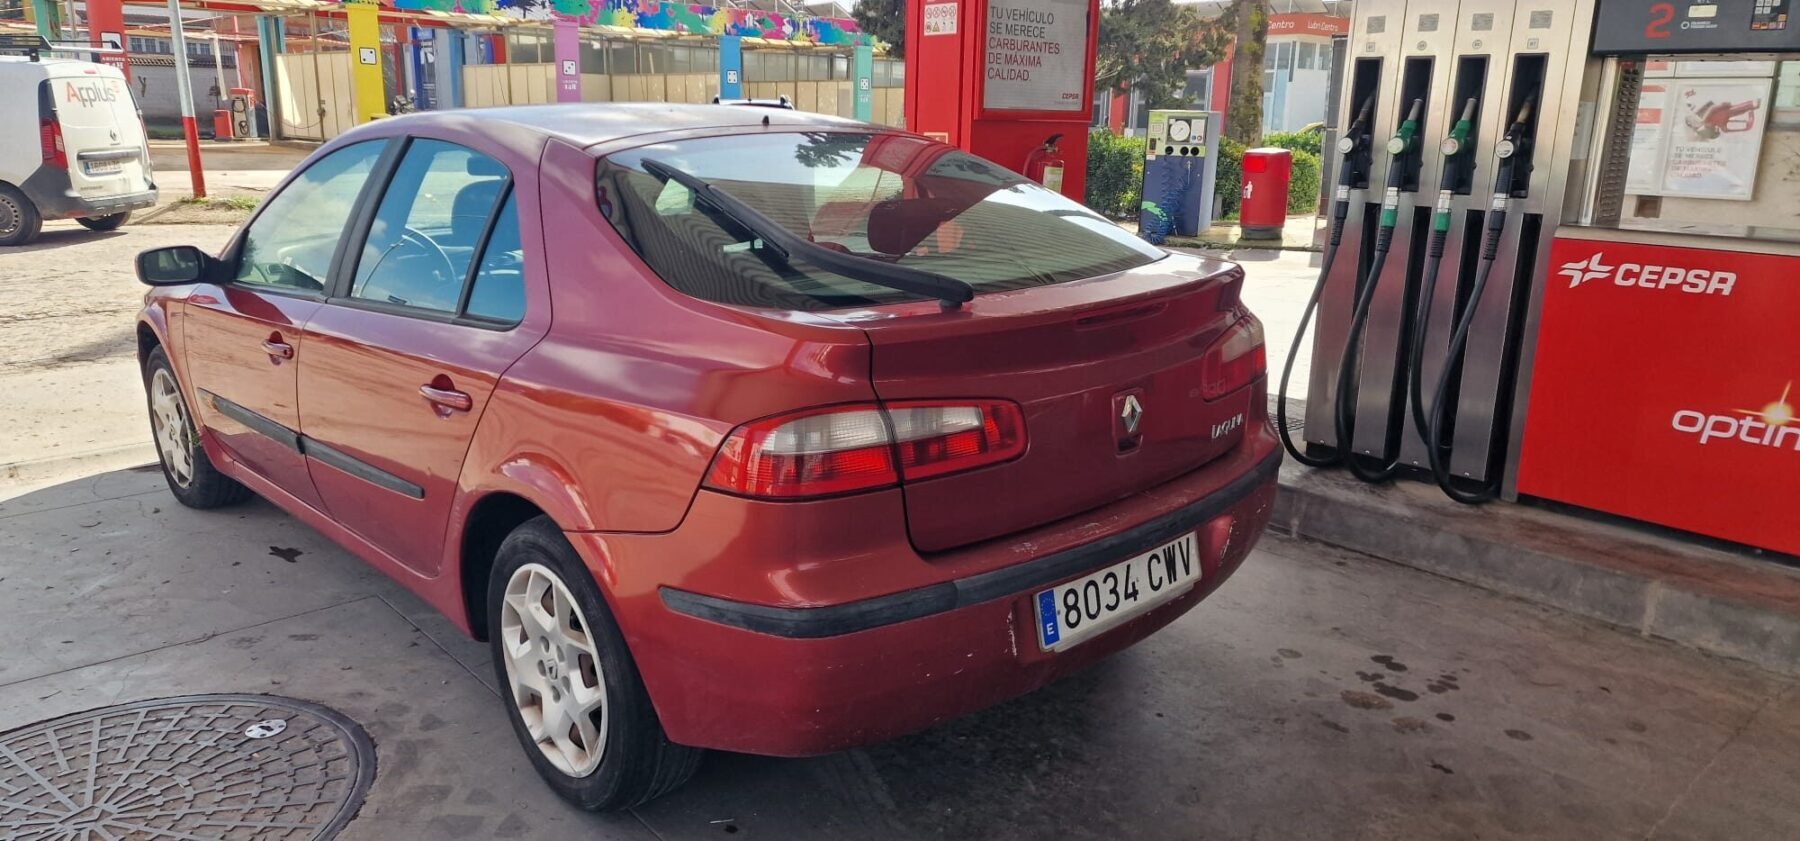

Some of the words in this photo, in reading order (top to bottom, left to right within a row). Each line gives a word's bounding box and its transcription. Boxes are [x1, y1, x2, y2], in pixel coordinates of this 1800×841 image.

[991, 6, 1003, 19] TU
[1006, 8, 1054, 25] VEHÍCULO
[1645, 3, 1674, 39] 2
[989, 21, 1003, 34] SE
[1005, 23, 1046, 38] MERECE
[988, 37, 1060, 54] CARBURANTES
[988, 52, 1001, 65] DE
[1004, 52, 1042, 67] MÁXIMA
[1614, 263, 1737, 296] CEPSA
[1046, 623, 1055, 635] E
[1063, 564, 1139, 629] 8034
[1148, 537, 1190, 591] CWV
